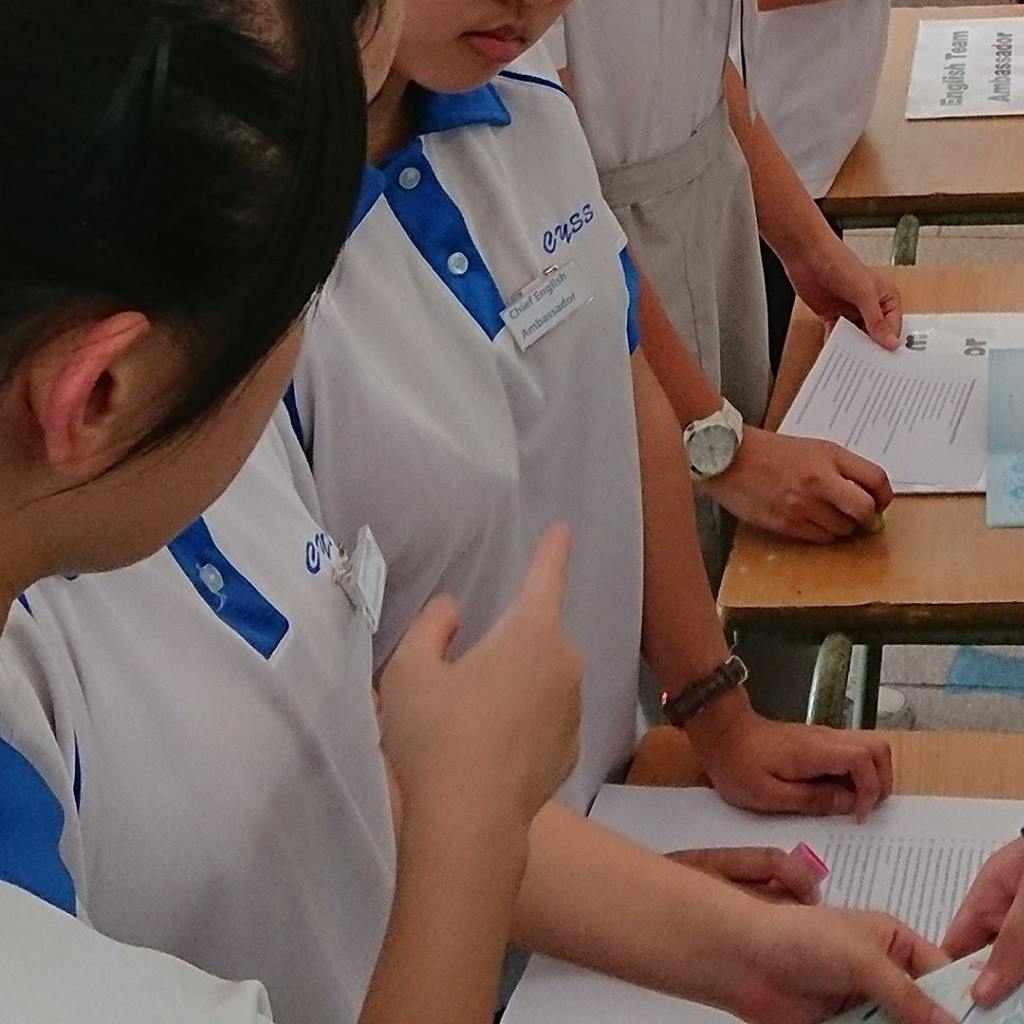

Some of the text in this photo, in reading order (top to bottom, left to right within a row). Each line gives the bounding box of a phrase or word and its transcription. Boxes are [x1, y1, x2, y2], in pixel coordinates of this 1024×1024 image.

[940, 30, 969, 106] English Team
[987, 32, 1013, 102] Ambassador
[509, 273, 567, 319] Chief English
[522, 293, 576, 337] Ambassador
